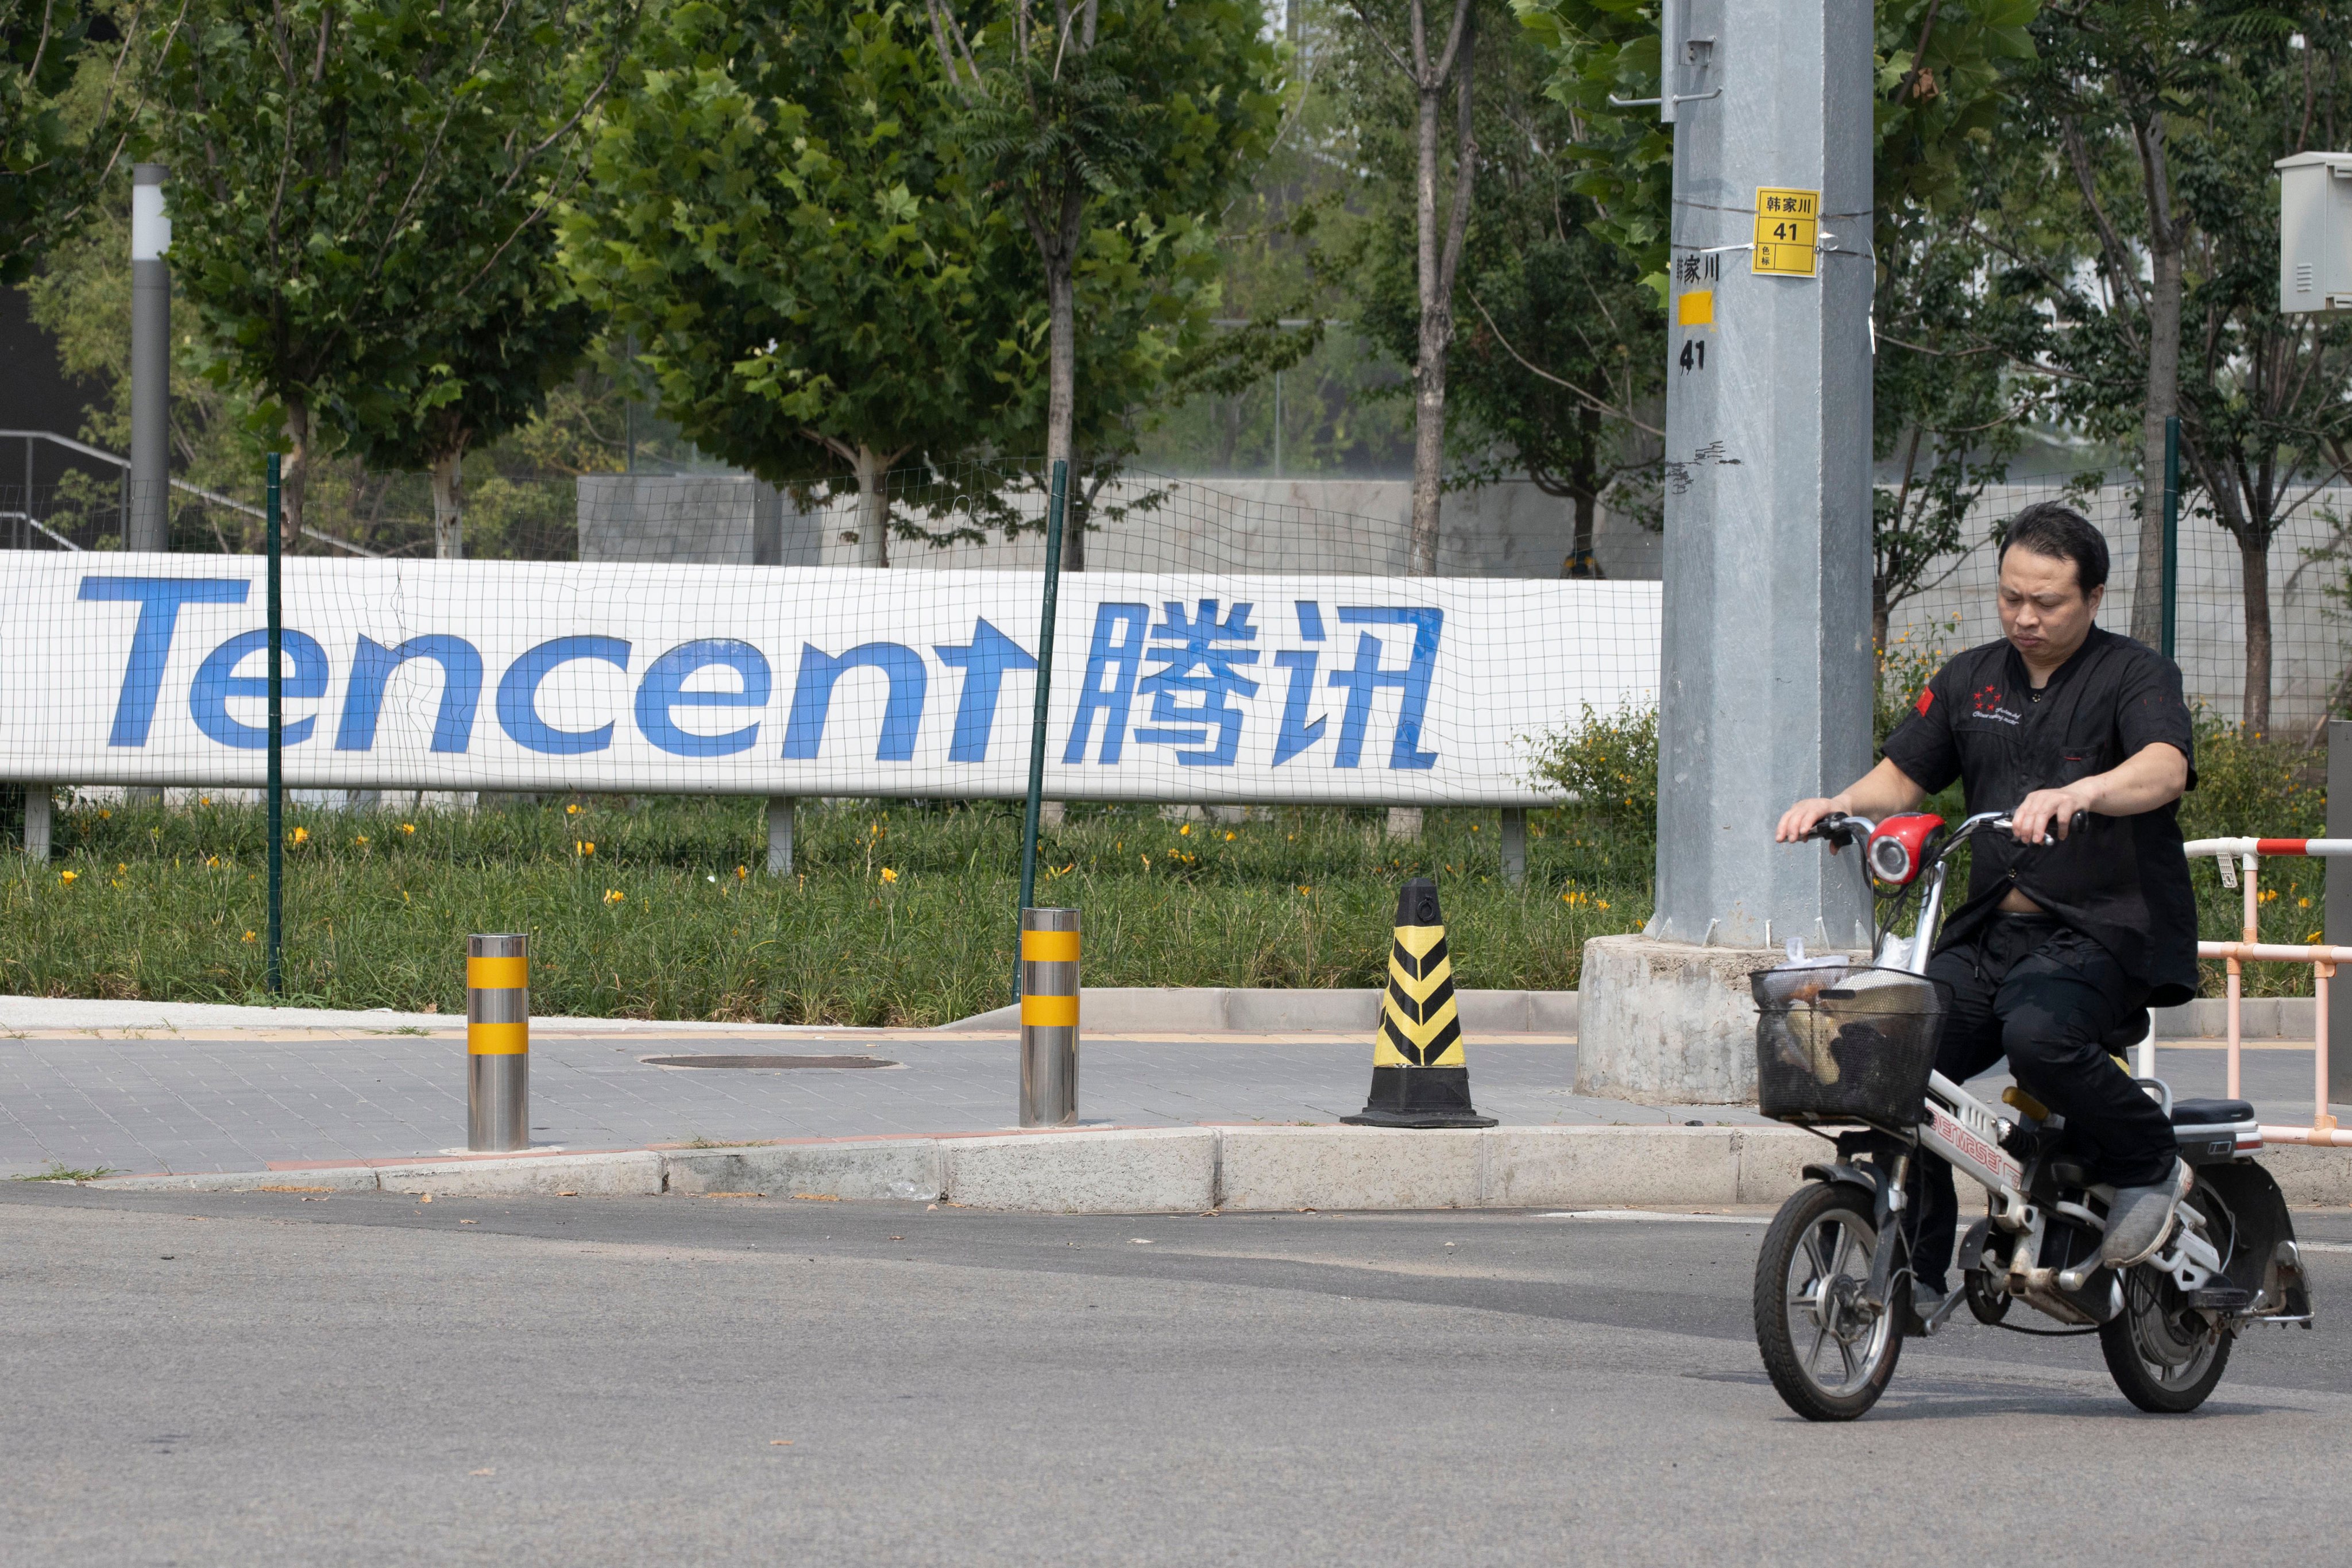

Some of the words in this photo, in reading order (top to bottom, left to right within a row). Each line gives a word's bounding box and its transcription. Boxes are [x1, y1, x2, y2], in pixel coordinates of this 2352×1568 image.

[1766, 196, 1811, 214] 韩家川
[1774, 222, 1797, 241] 41
[1762, 246, 1770, 265] 色标
[1680, 339, 1705, 372] 41
[77, 576, 1038, 763] Tencent
[1061, 599, 1444, 770] 腾讯
